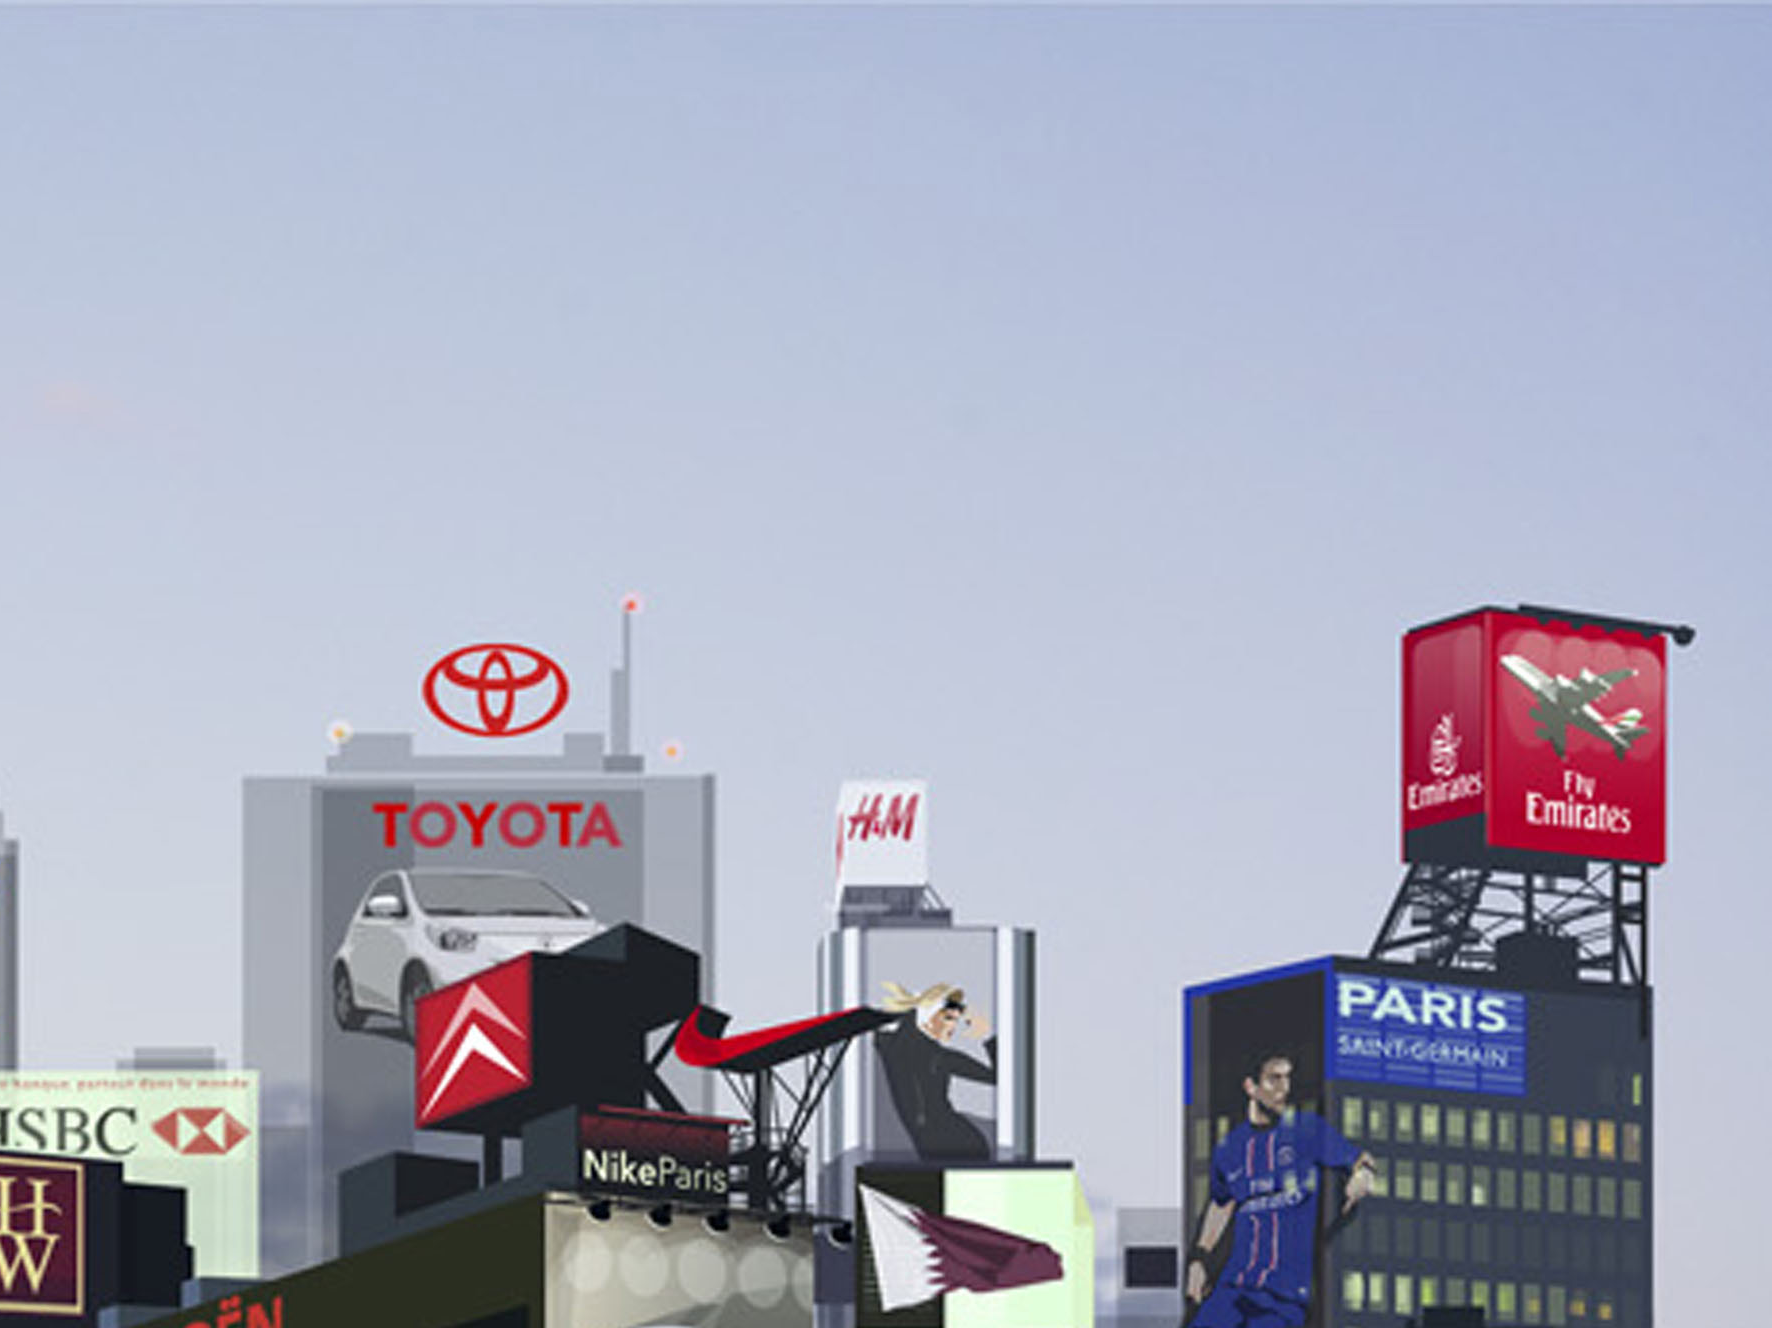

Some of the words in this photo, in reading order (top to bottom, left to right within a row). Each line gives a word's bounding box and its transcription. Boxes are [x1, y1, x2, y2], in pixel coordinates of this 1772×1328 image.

[1407, 770, 1483, 811] Emirates
[1563, 769, 1596, 798] Fly
[373, 801, 622, 848] TOYOTA
[846, 792, 920, 842] H&M
[1526, 792, 1632, 835] Emirates
[1337, 979, 1508, 1032] PARIS
[1337, 1033, 1509, 1069] SAINT-GERMAIN
